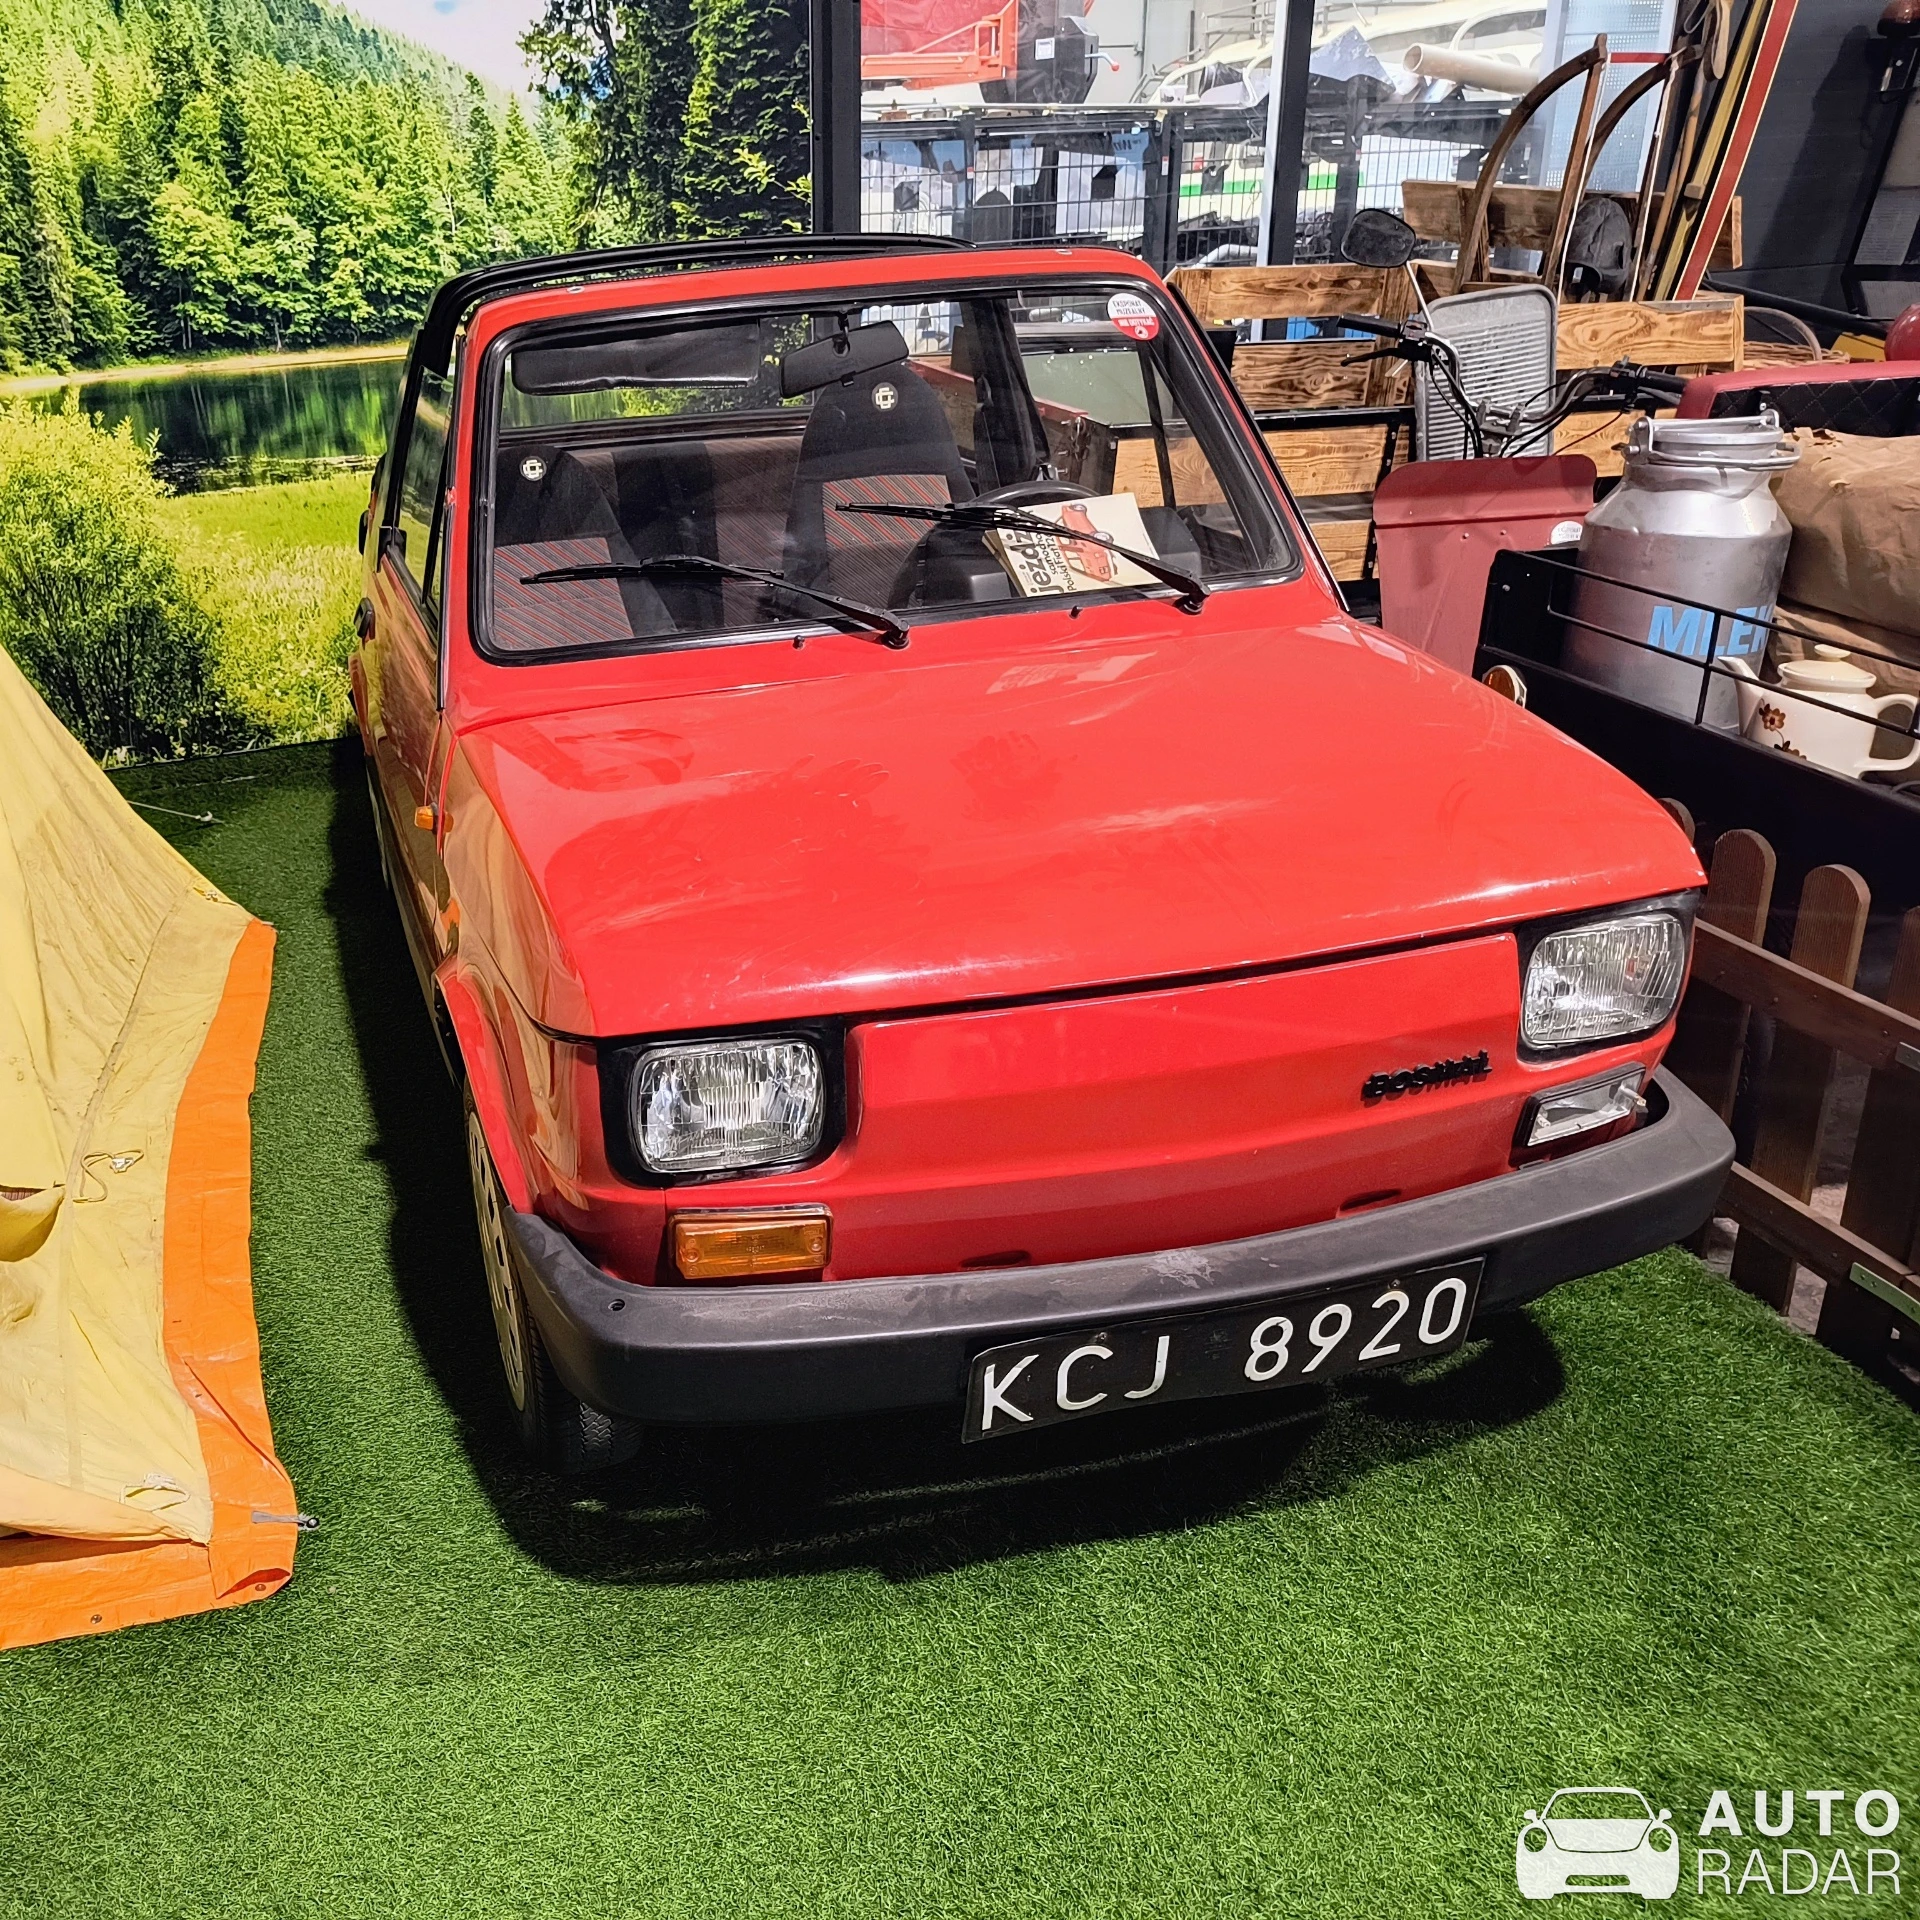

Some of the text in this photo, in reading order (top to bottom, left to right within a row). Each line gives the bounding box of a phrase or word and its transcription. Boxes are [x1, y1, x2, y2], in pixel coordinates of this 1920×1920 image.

[1006, 530, 1064, 594] jeżdż
[1646, 604, 1774, 655] MLEK
[982, 1277, 1467, 1431] KCJ 8920
